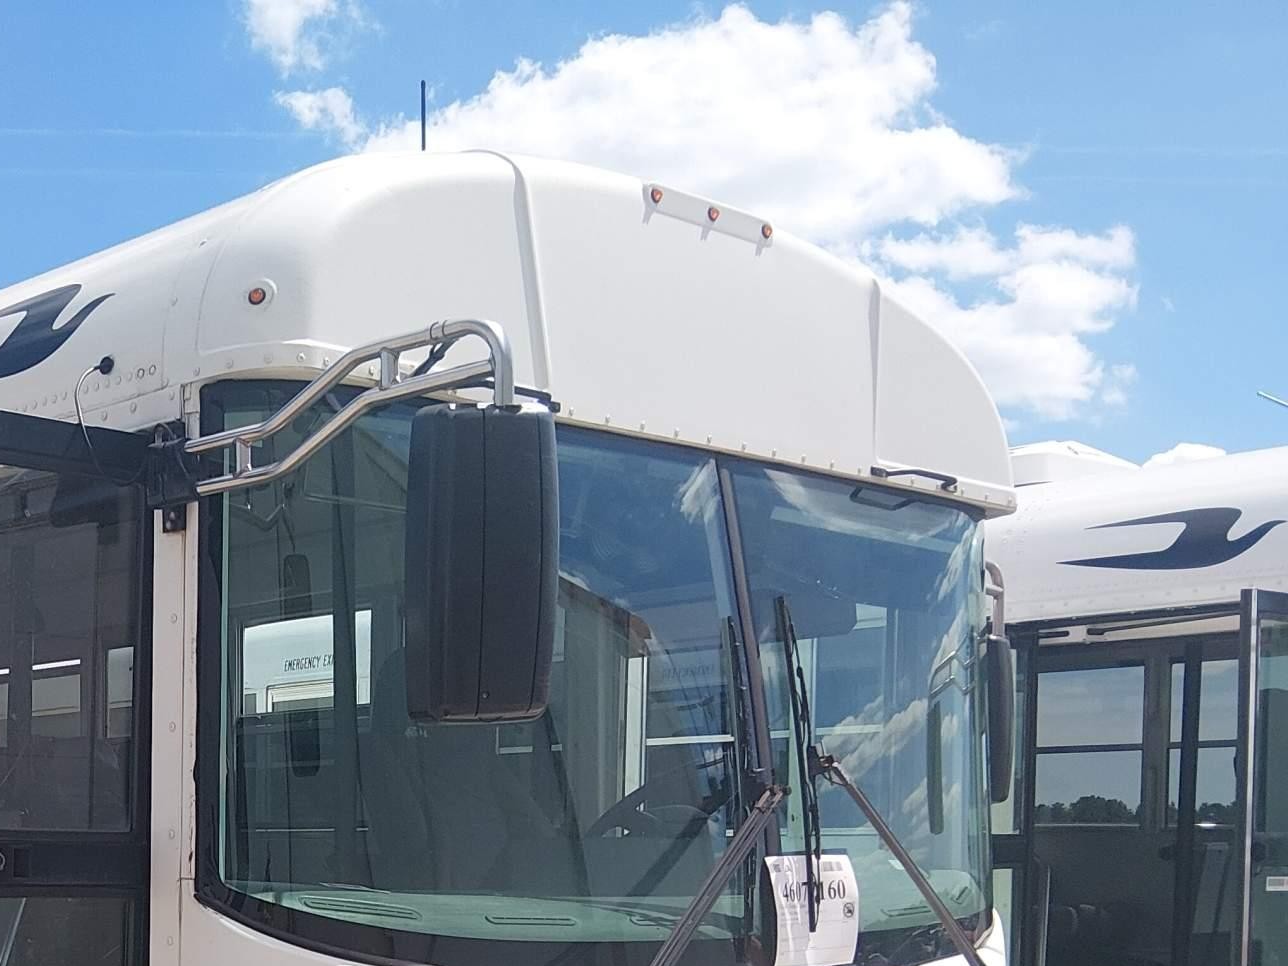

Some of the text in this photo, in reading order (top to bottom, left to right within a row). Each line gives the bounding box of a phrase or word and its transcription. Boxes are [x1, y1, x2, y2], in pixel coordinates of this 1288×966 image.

[284, 654, 334, 672] EMERGENCY EX
[783, 880, 846, 902] 4607160
